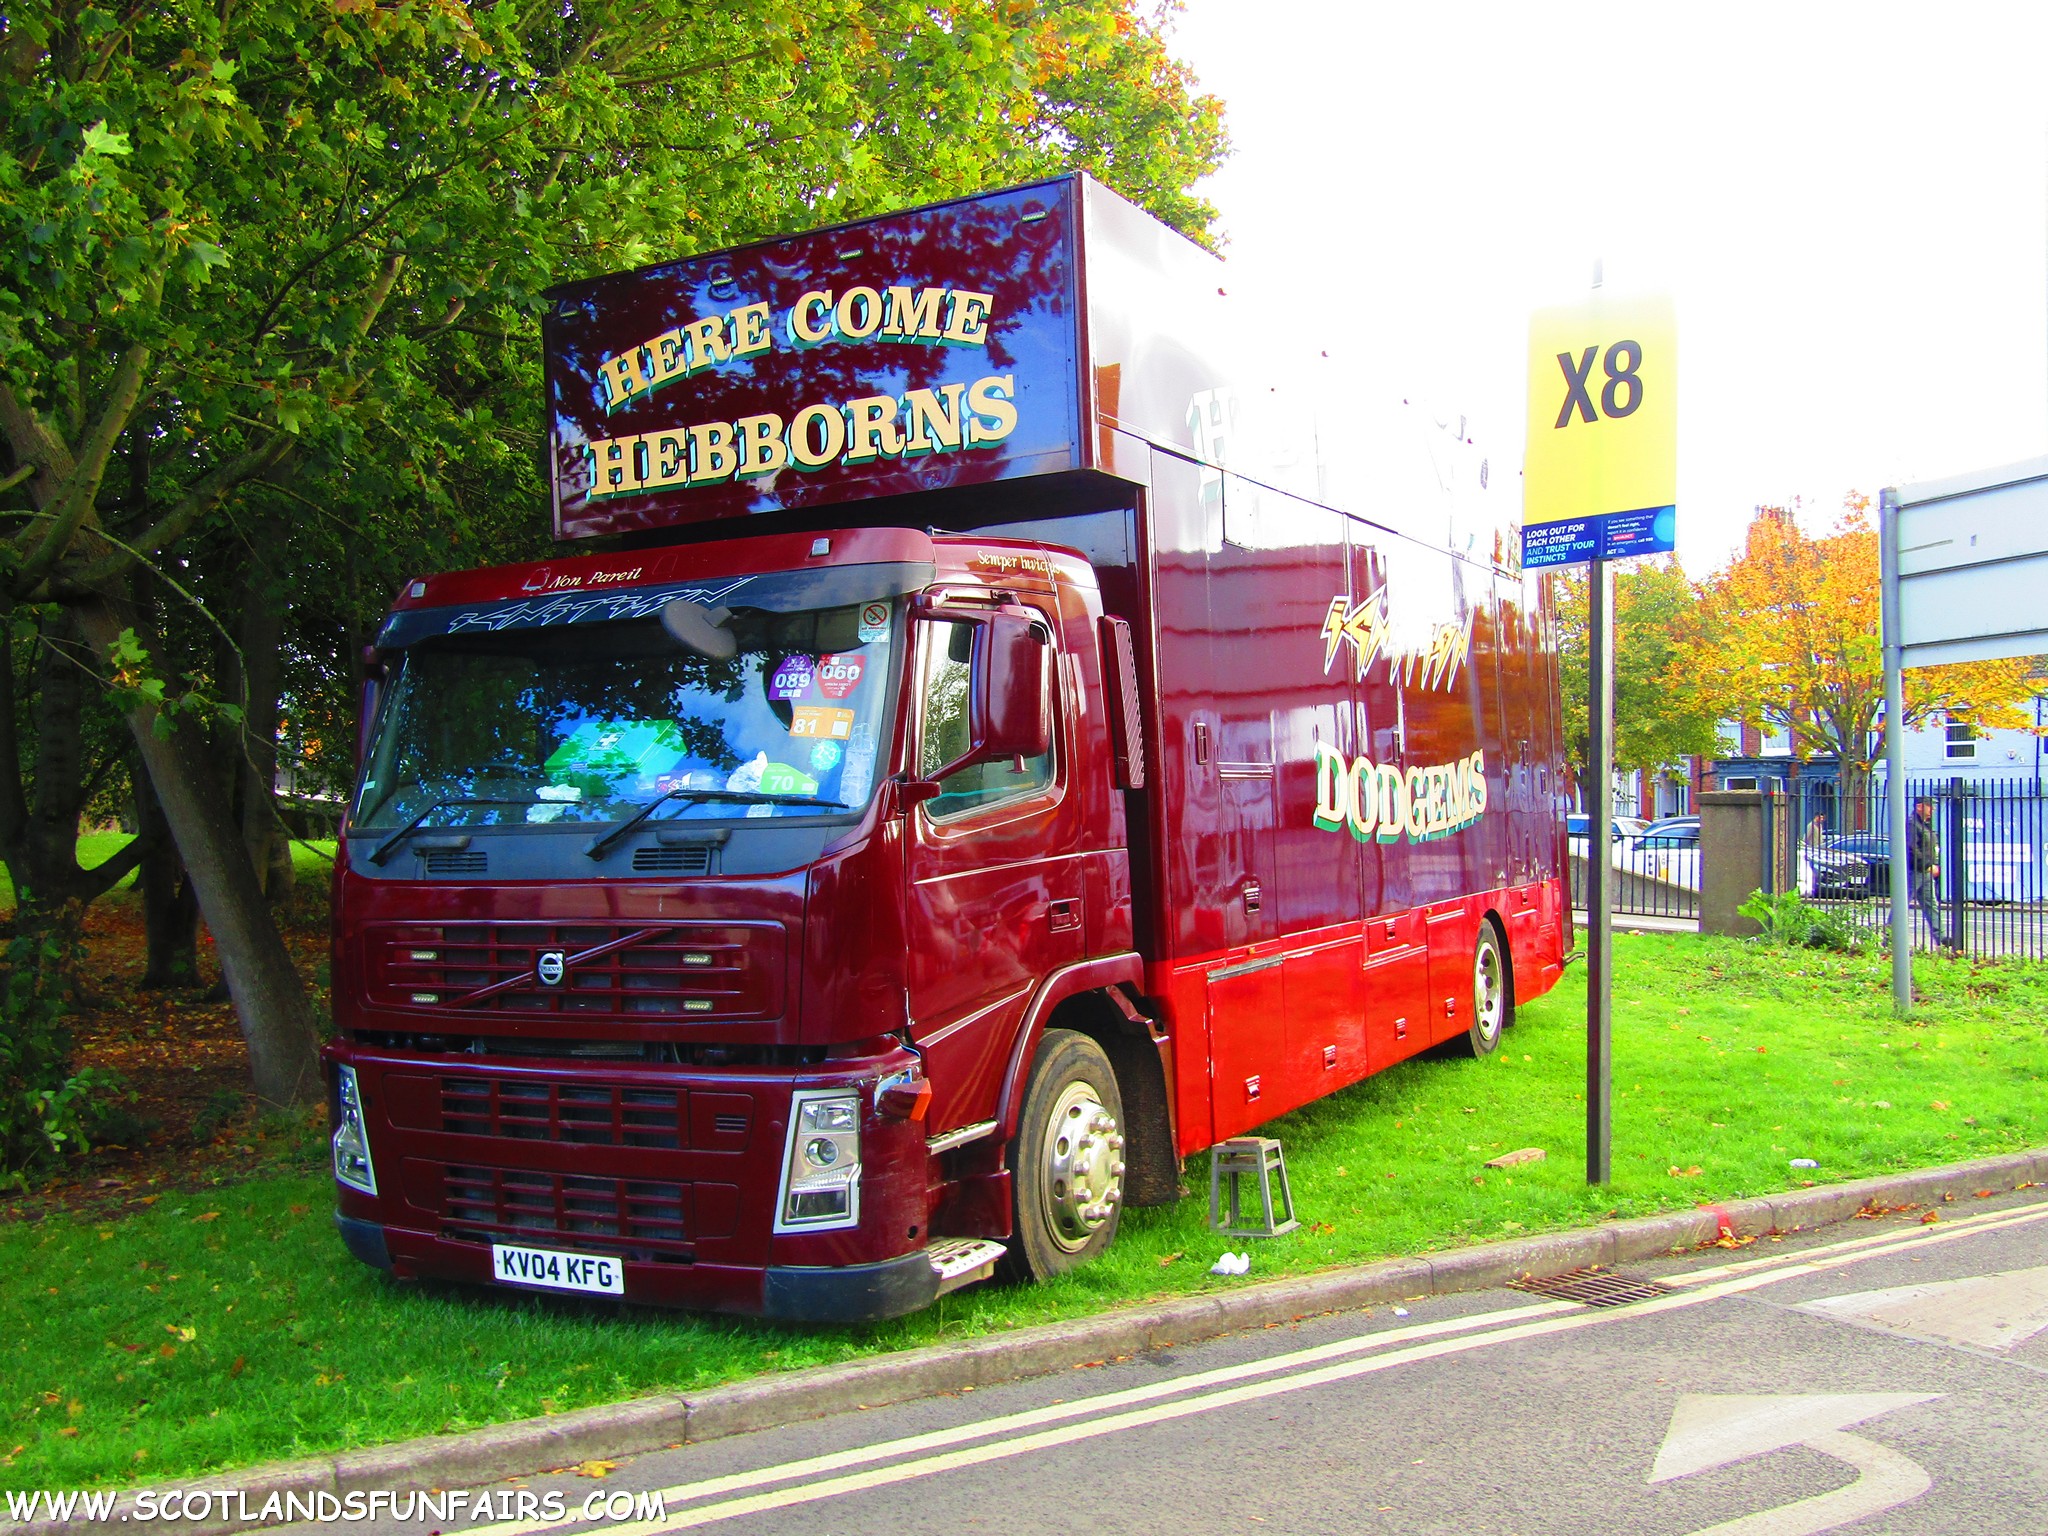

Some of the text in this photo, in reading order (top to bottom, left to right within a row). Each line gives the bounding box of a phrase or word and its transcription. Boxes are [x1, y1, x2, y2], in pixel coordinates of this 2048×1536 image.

[600, 286, 994, 412] HERE COME
[1554, 340, 1643, 429] X8
[587, 375, 1018, 498] HEBBORNS
[1526, 524, 1585, 539] LOOK OUT FOR
[1526, 534, 1576, 547] EACH OTHER
[1526, 540, 1595, 556] AND TRUST YOUR
[977, 550, 1018, 572] Semper
[1526, 553, 1566, 565] INSTINCTS
[548, 567, 642, 588] Non Pareil
[775, 673, 811, 688] 089
[793, 718, 817, 734] 81
[770, 775, 794, 791] 70
[1313, 739, 1488, 844] DODGEMS
[503, 1250, 612, 1287] KV04 KFG
